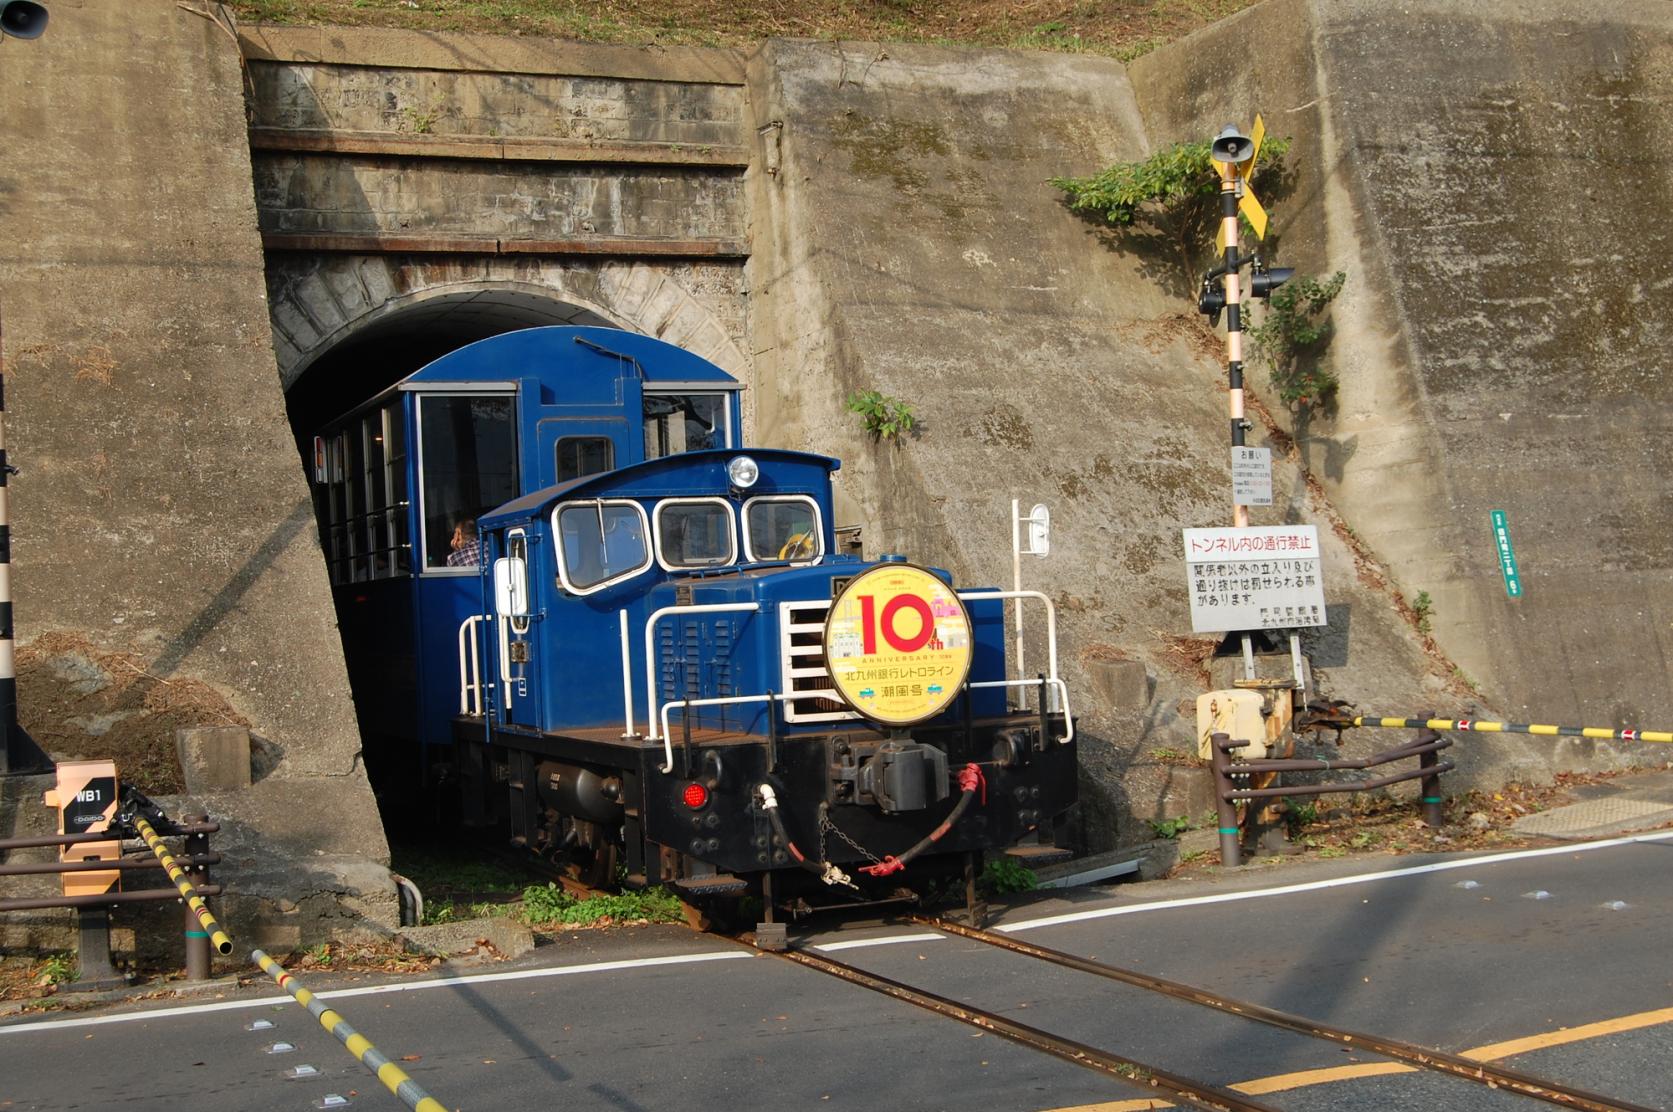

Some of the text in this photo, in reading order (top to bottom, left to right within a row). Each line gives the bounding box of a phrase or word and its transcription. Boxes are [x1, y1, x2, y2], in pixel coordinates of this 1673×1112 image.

[1192, 535, 1311, 552] トンネル内の通行禁止
[861, 655, 935, 664] ANNIVERSARY
[845, 665, 954, 681] 北九州銀行レトロライン
[881, 684, 923, 698] 潮風号
[76, 790, 101, 802] WB1
